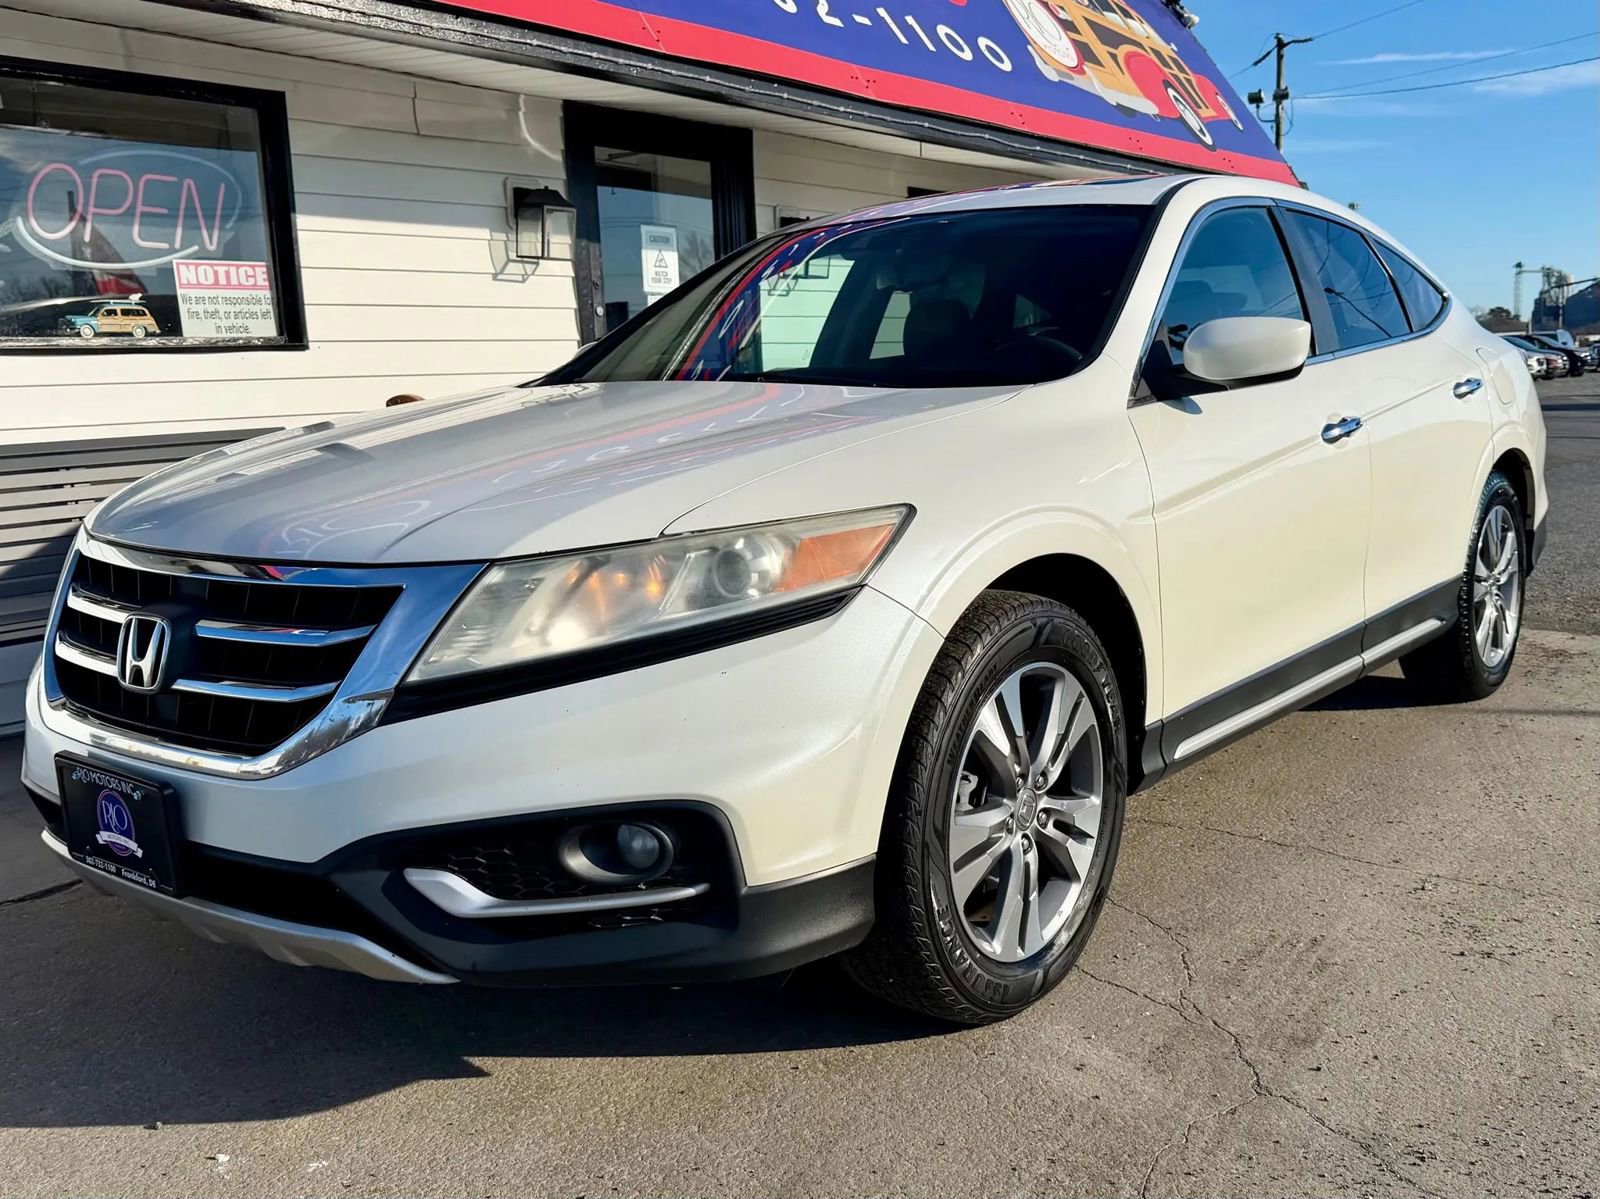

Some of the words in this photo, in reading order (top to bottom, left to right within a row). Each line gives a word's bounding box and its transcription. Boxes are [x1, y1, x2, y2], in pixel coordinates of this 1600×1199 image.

[27, 162, 225, 251] OPEN
[179, 264, 270, 286] NOTICE
[181, 294, 193, 305] We
[194, 296, 207, 305] are
[208, 295, 220, 305] not
[221, 294, 263, 307] responsible
[187, 308, 203, 321] fire,
[224, 311, 232, 320] or
[233, 309, 260, 320] articles
[260, 309, 272, 321] left
[215, 323, 223, 334] in
[224, 323, 252, 335] vehicle.
[89, 771, 122, 792] MOTORS
